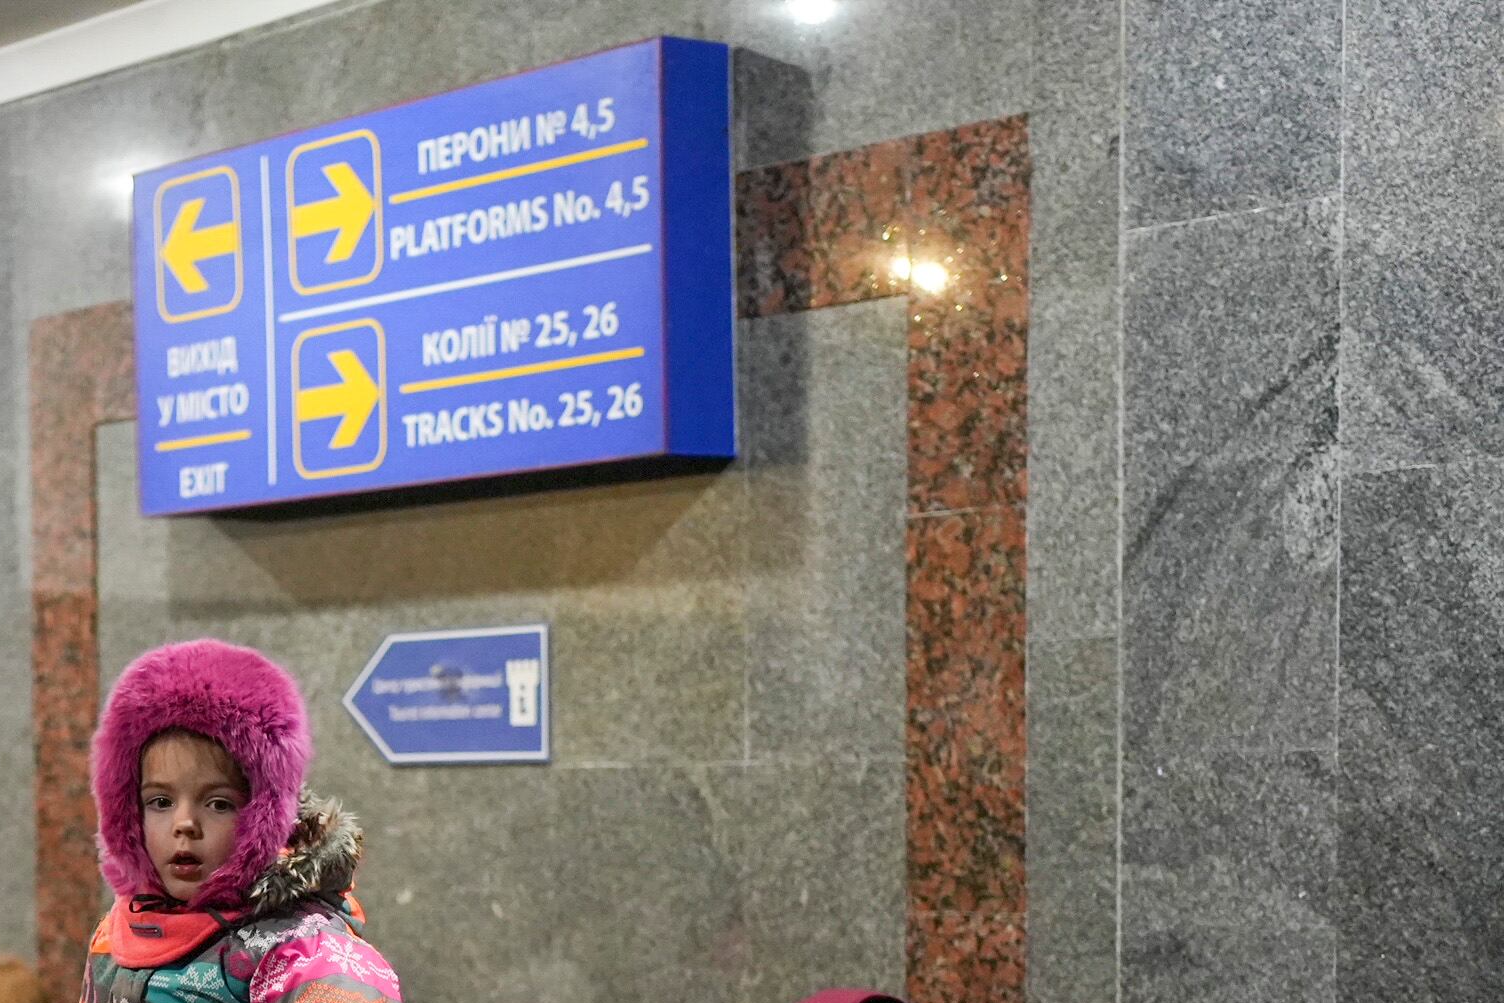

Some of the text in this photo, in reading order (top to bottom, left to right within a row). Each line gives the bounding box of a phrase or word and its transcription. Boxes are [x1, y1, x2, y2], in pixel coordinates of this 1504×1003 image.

[417, 97, 616, 175] ПЕРОНИ № 4,5
[389, 175, 650, 261] PLATFORMS No. 4,5
[167, 335, 239, 378] ВИХІД
[422, 301, 619, 366] КОЛІЇ № 25, 26
[156, 382, 249, 427] У МІСТО
[401, 382, 643, 448] TRACKS No. 25, 26
[179, 462, 229, 499] EXIT
